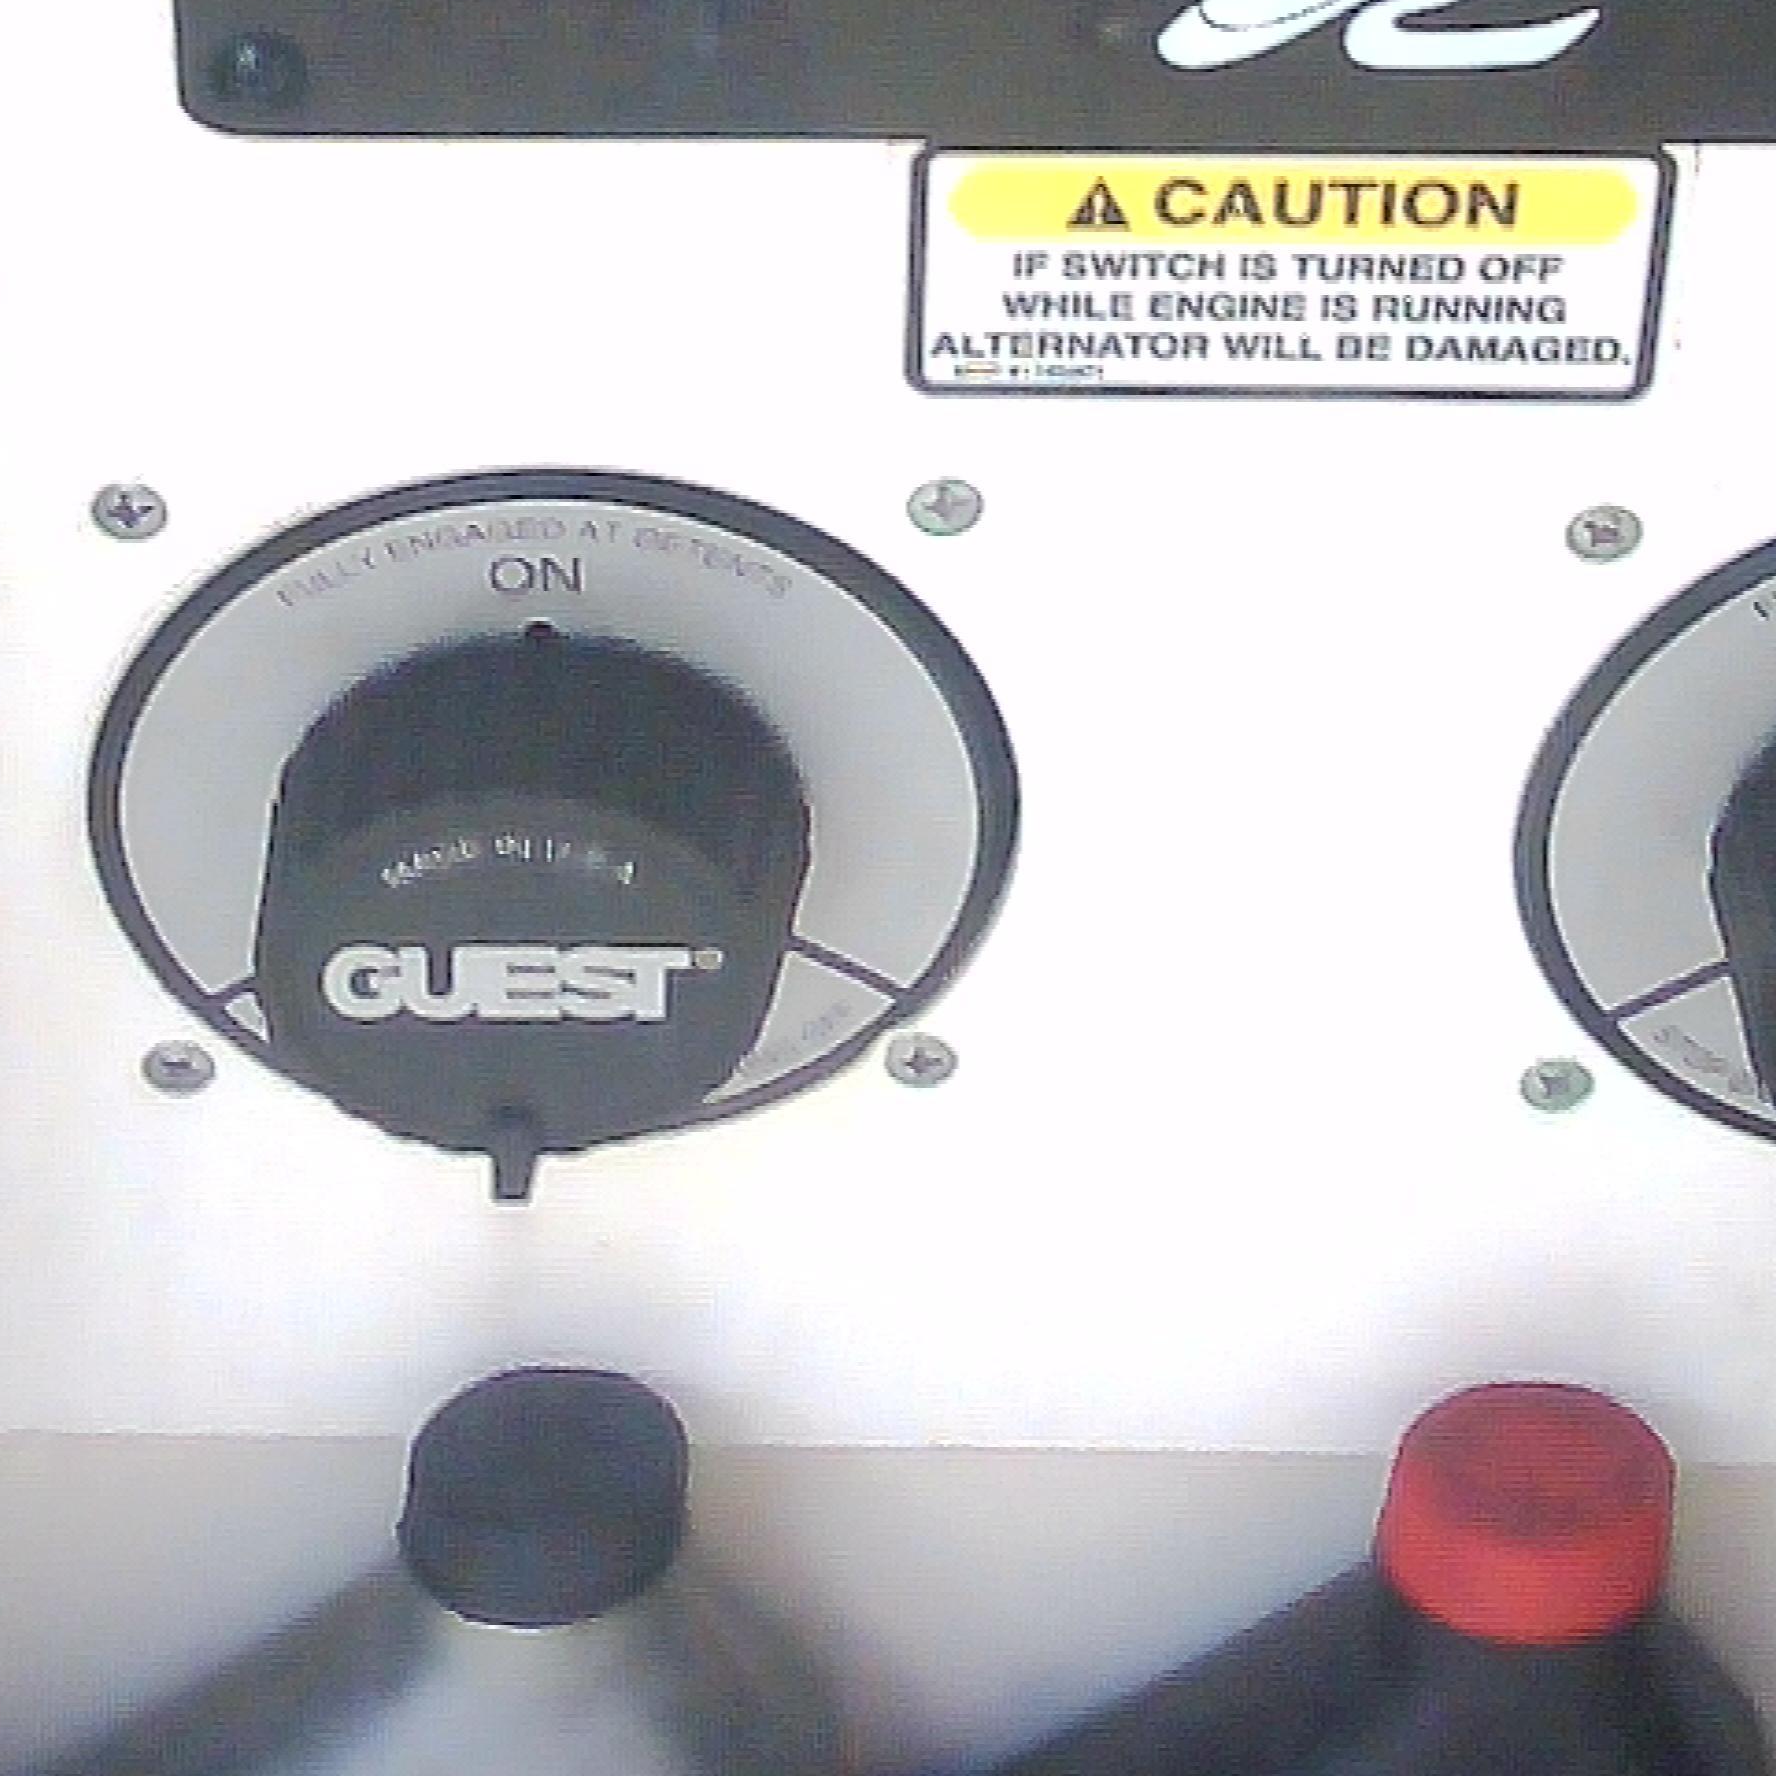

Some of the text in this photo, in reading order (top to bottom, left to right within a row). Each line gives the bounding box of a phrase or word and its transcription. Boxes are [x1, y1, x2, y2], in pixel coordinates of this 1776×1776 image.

[1155, 180, 1518, 228] CAUTION
[1014, 254, 1562, 284] IF SWITCH IS TURNED OFF
[1003, 294, 1565, 324] WHILE ENGINE IS RUNNING
[931, 332, 1630, 365] ALTERNATOR WILL BE DAMAGED.
[489, 558, 581, 598] ON
[325, 946, 692, 1022] GUEST
